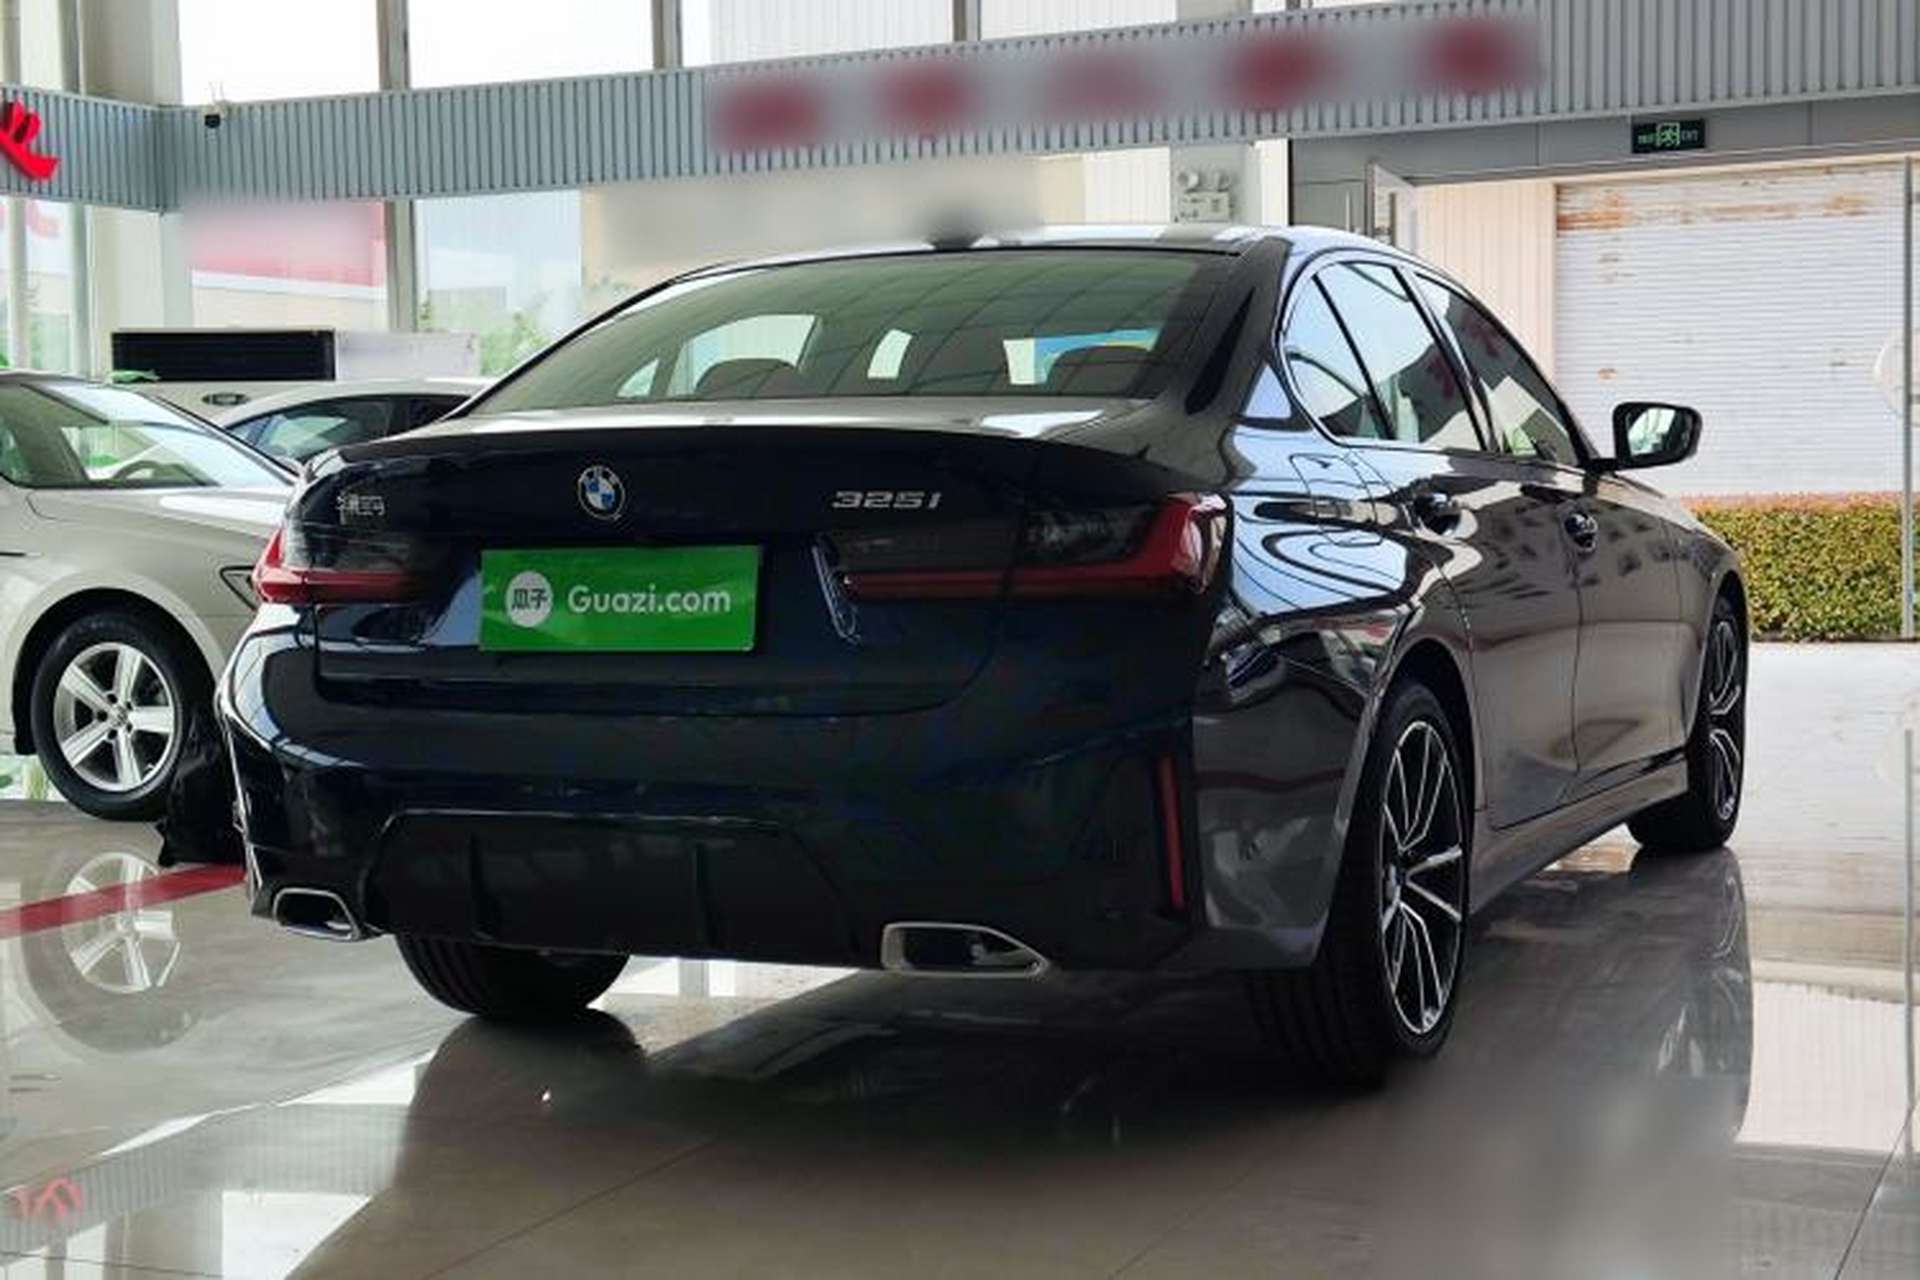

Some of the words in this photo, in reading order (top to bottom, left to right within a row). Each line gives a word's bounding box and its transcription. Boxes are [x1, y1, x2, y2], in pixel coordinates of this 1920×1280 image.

[832, 490, 942, 509] 325i
[511, 588, 547, 611] 瓜子
[567, 584, 731, 613] Guazi.com
